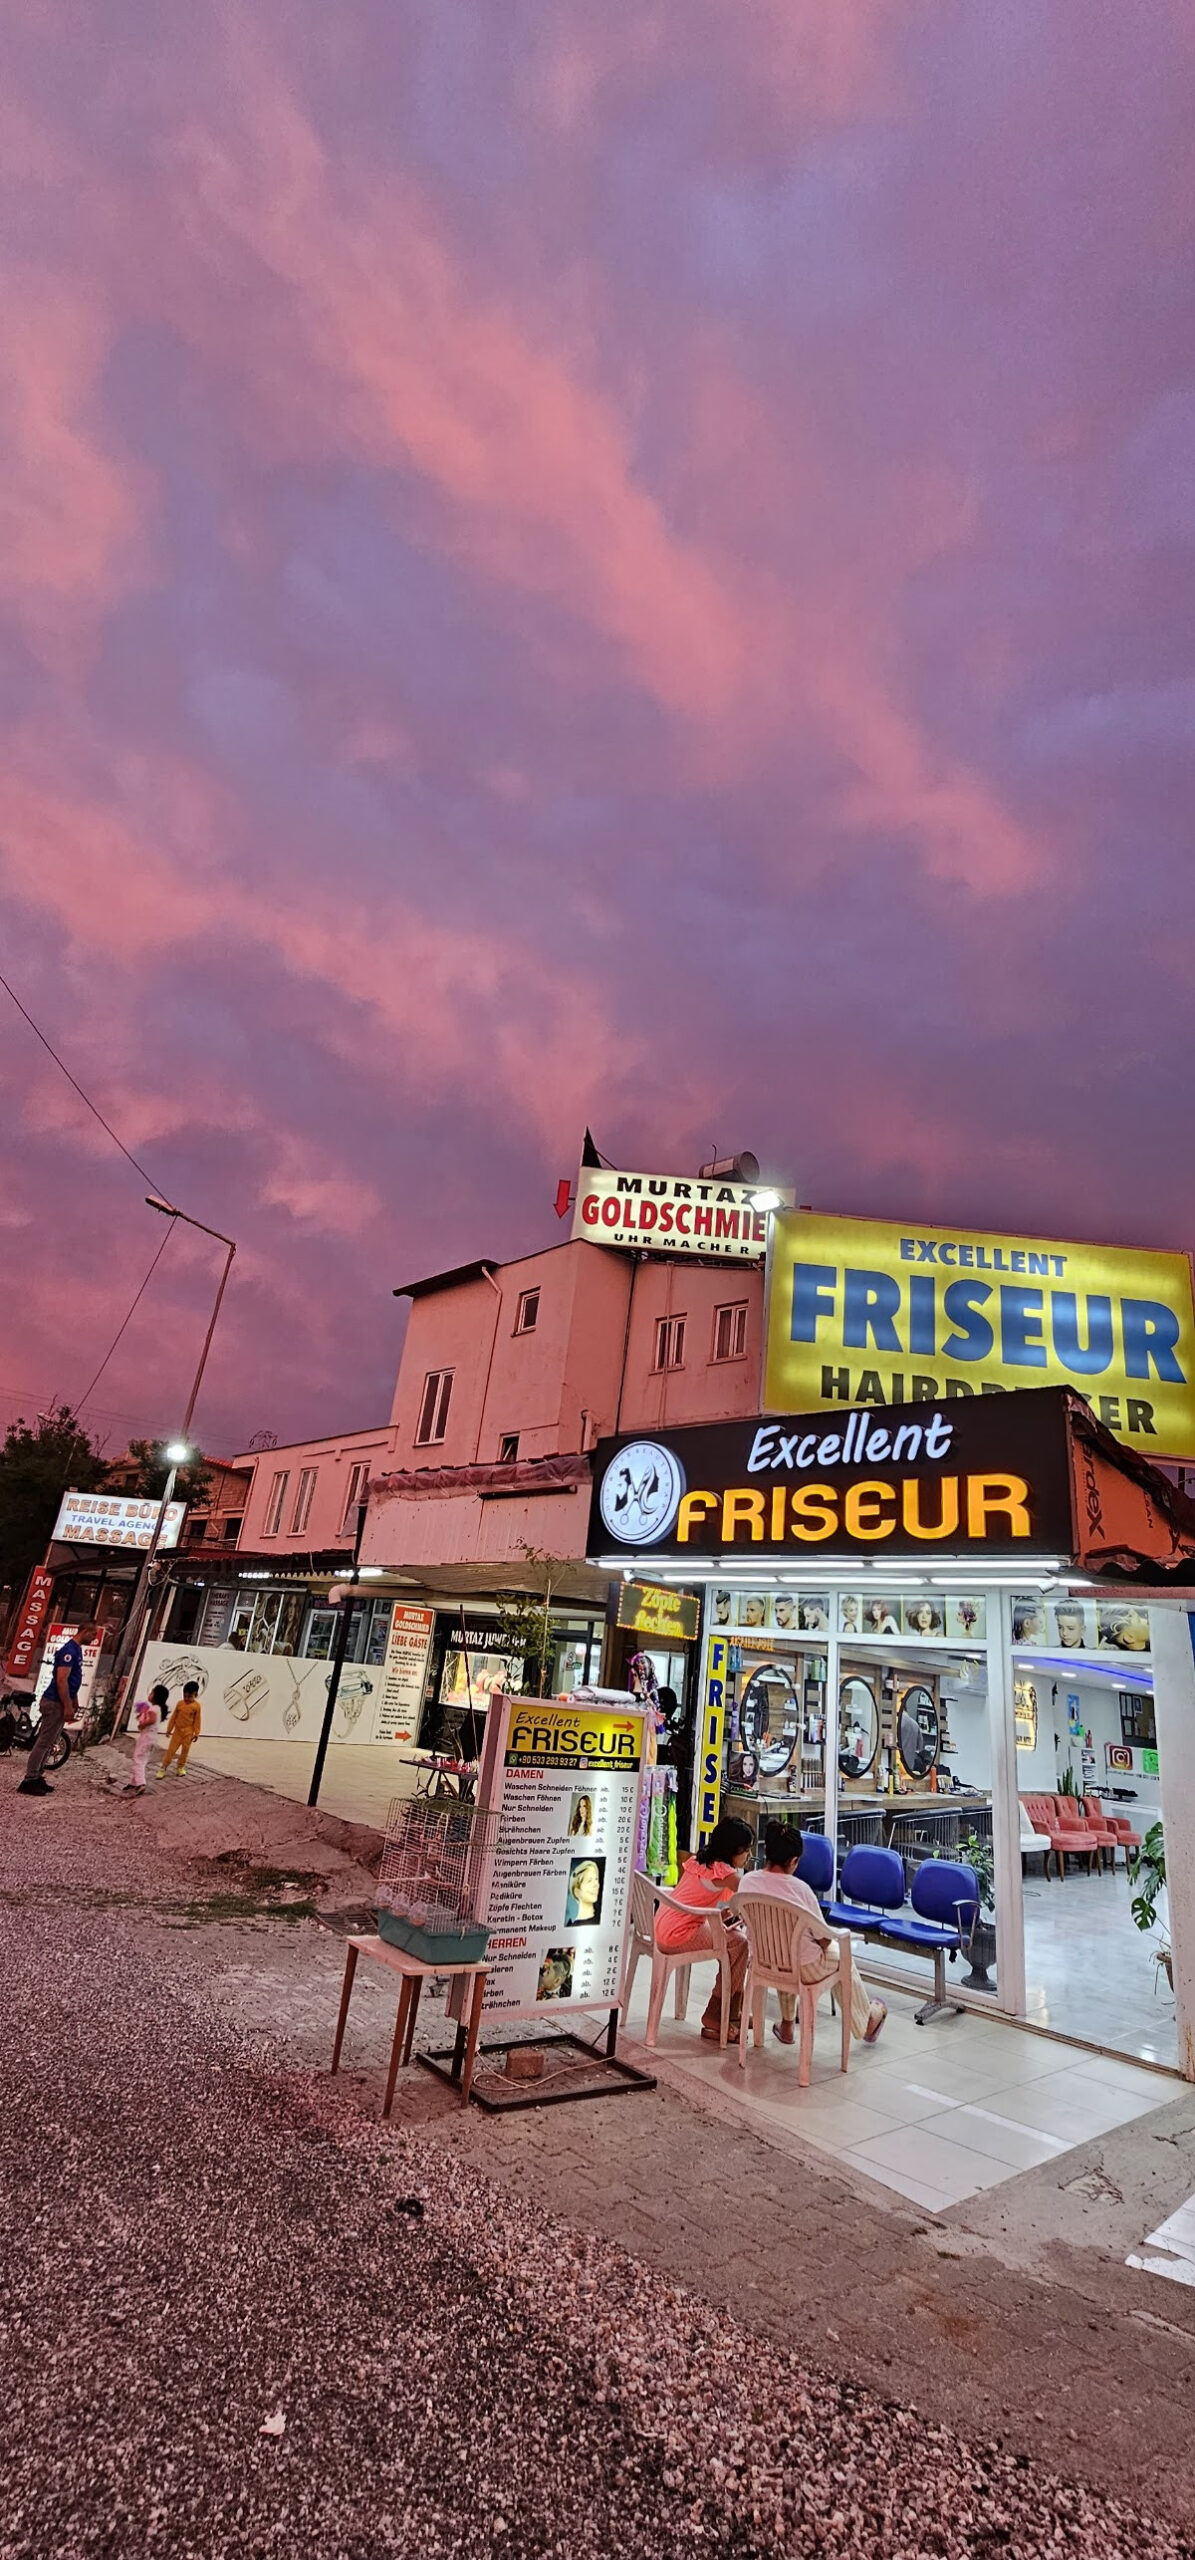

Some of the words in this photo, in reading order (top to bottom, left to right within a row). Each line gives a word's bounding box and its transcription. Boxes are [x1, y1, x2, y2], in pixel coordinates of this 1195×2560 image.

[617, 1177, 760, 1206] MURTAZ
[582, 1194, 767, 1242] GOLDSCHMIE
[614, 1233, 652, 1245] UHR
[663, 1238, 750, 1255] MACHER
[900, 1238, 1068, 1278] EXCELLENT
[790, 1262, 1187, 1384] FRISEUR
[821, 1365, 1158, 1434] HAIRDER
[746, 1411, 954, 1473] Excellent
[66, 1498, 122, 1516] REISE
[676, 1473, 1032, 1542] FRISEUR
[71, 1514, 117, 1526] TRAVEL
[62, 1524, 168, 1549] MASSAGE
[13, 1576, 51, 1665] MASSAGE
[451, 1629, 485, 1645] MURTAZ
[515, 1711, 581, 1727] Excellent
[511, 1726, 635, 1755] FRISEUR
[532, 1755, 545, 1764] 533
[568, 1758, 578, 1766] 27
[506, 1768, 544, 1779] DAMEN
[504, 1782, 537, 1791] Waschen
[537, 1784, 573, 1792] Schneiden
[503, 1793, 535, 1801] Waschen
[536, 1794, 561, 1802] Föhnen
[517, 1804, 554, 1812] Schneiden
[546, 1837, 570, 1845] Zupfen
[552, 1847, 575, 1856] Zupfen
[494, 1859, 528, 1868] Wimpern
[542, 1869, 567, 1877] Färben
[510, 1903, 542, 1911] Flechten
[496, 1926, 527, 1934] rmanent
[528, 1924, 557, 1933] Makeup
[487, 1937, 527, 1949] HERREN
[482, 1953, 498, 1962] Nur
[498, 1952, 537, 1960] Schneiden
[490, 1965, 514, 1973] sieren
[485, 1978, 496, 1986] ax
[483, 1989, 504, 1997] rben
[481, 1999, 521, 2010] trähnchen
